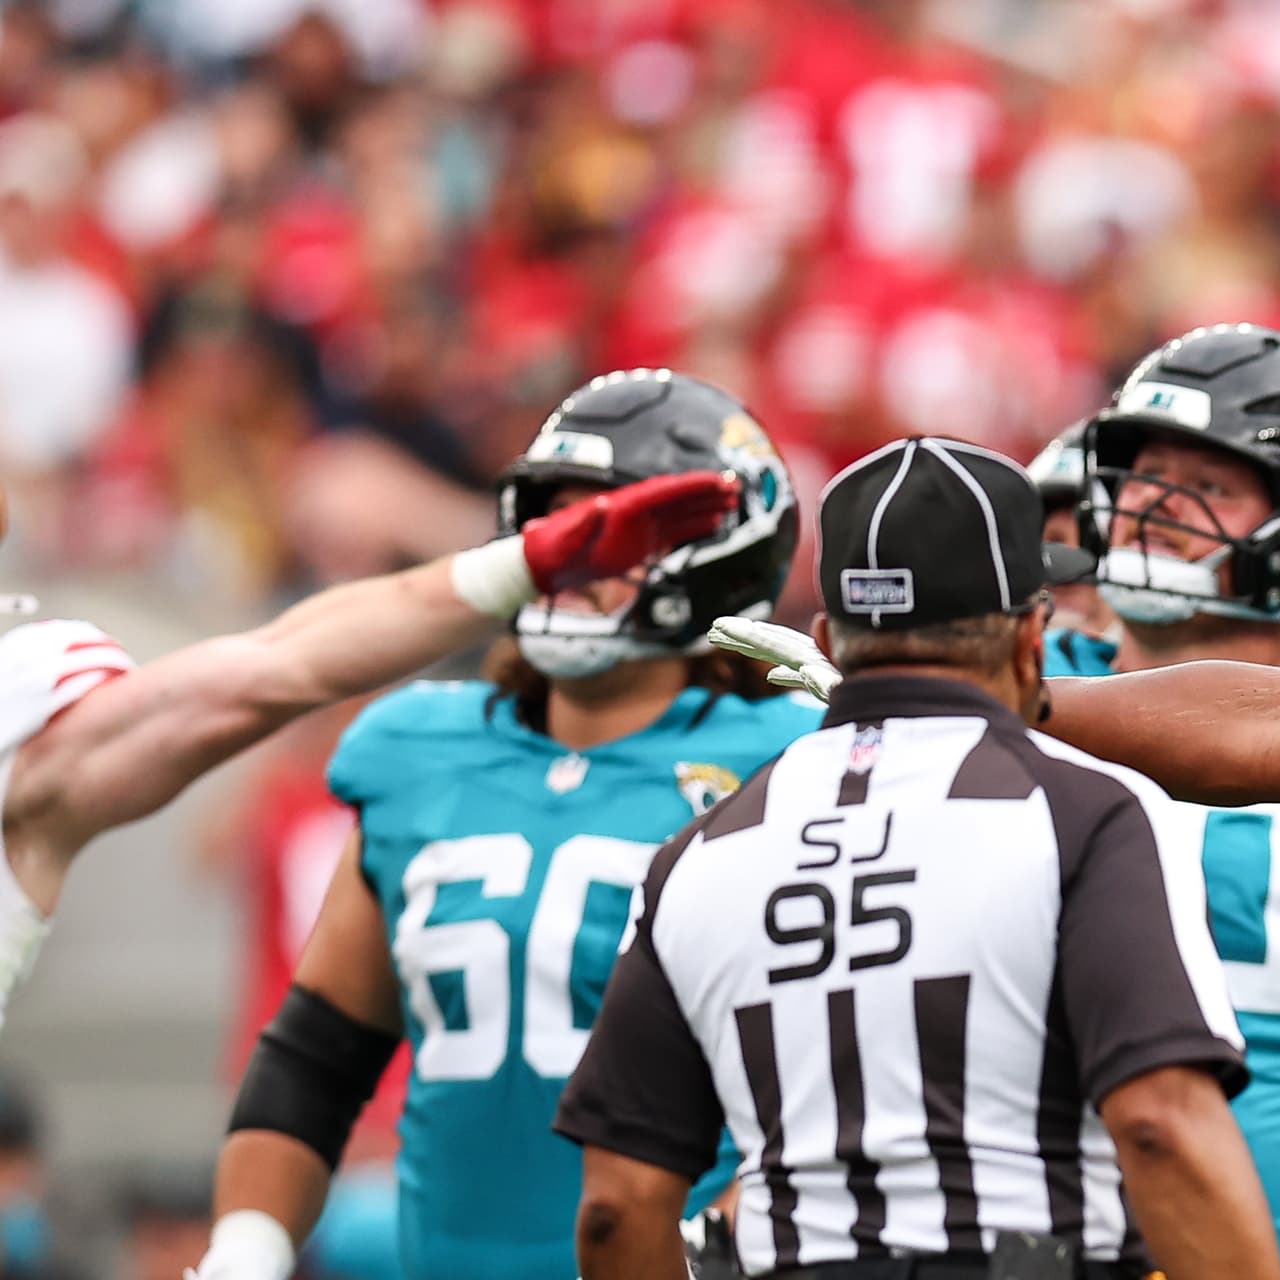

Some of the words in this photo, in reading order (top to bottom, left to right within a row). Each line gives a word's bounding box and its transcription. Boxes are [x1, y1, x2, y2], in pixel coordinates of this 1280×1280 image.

[796, 810, 893, 871] SJ
[392, 832, 660, 1083] 60
[764, 868, 917, 985] 95
